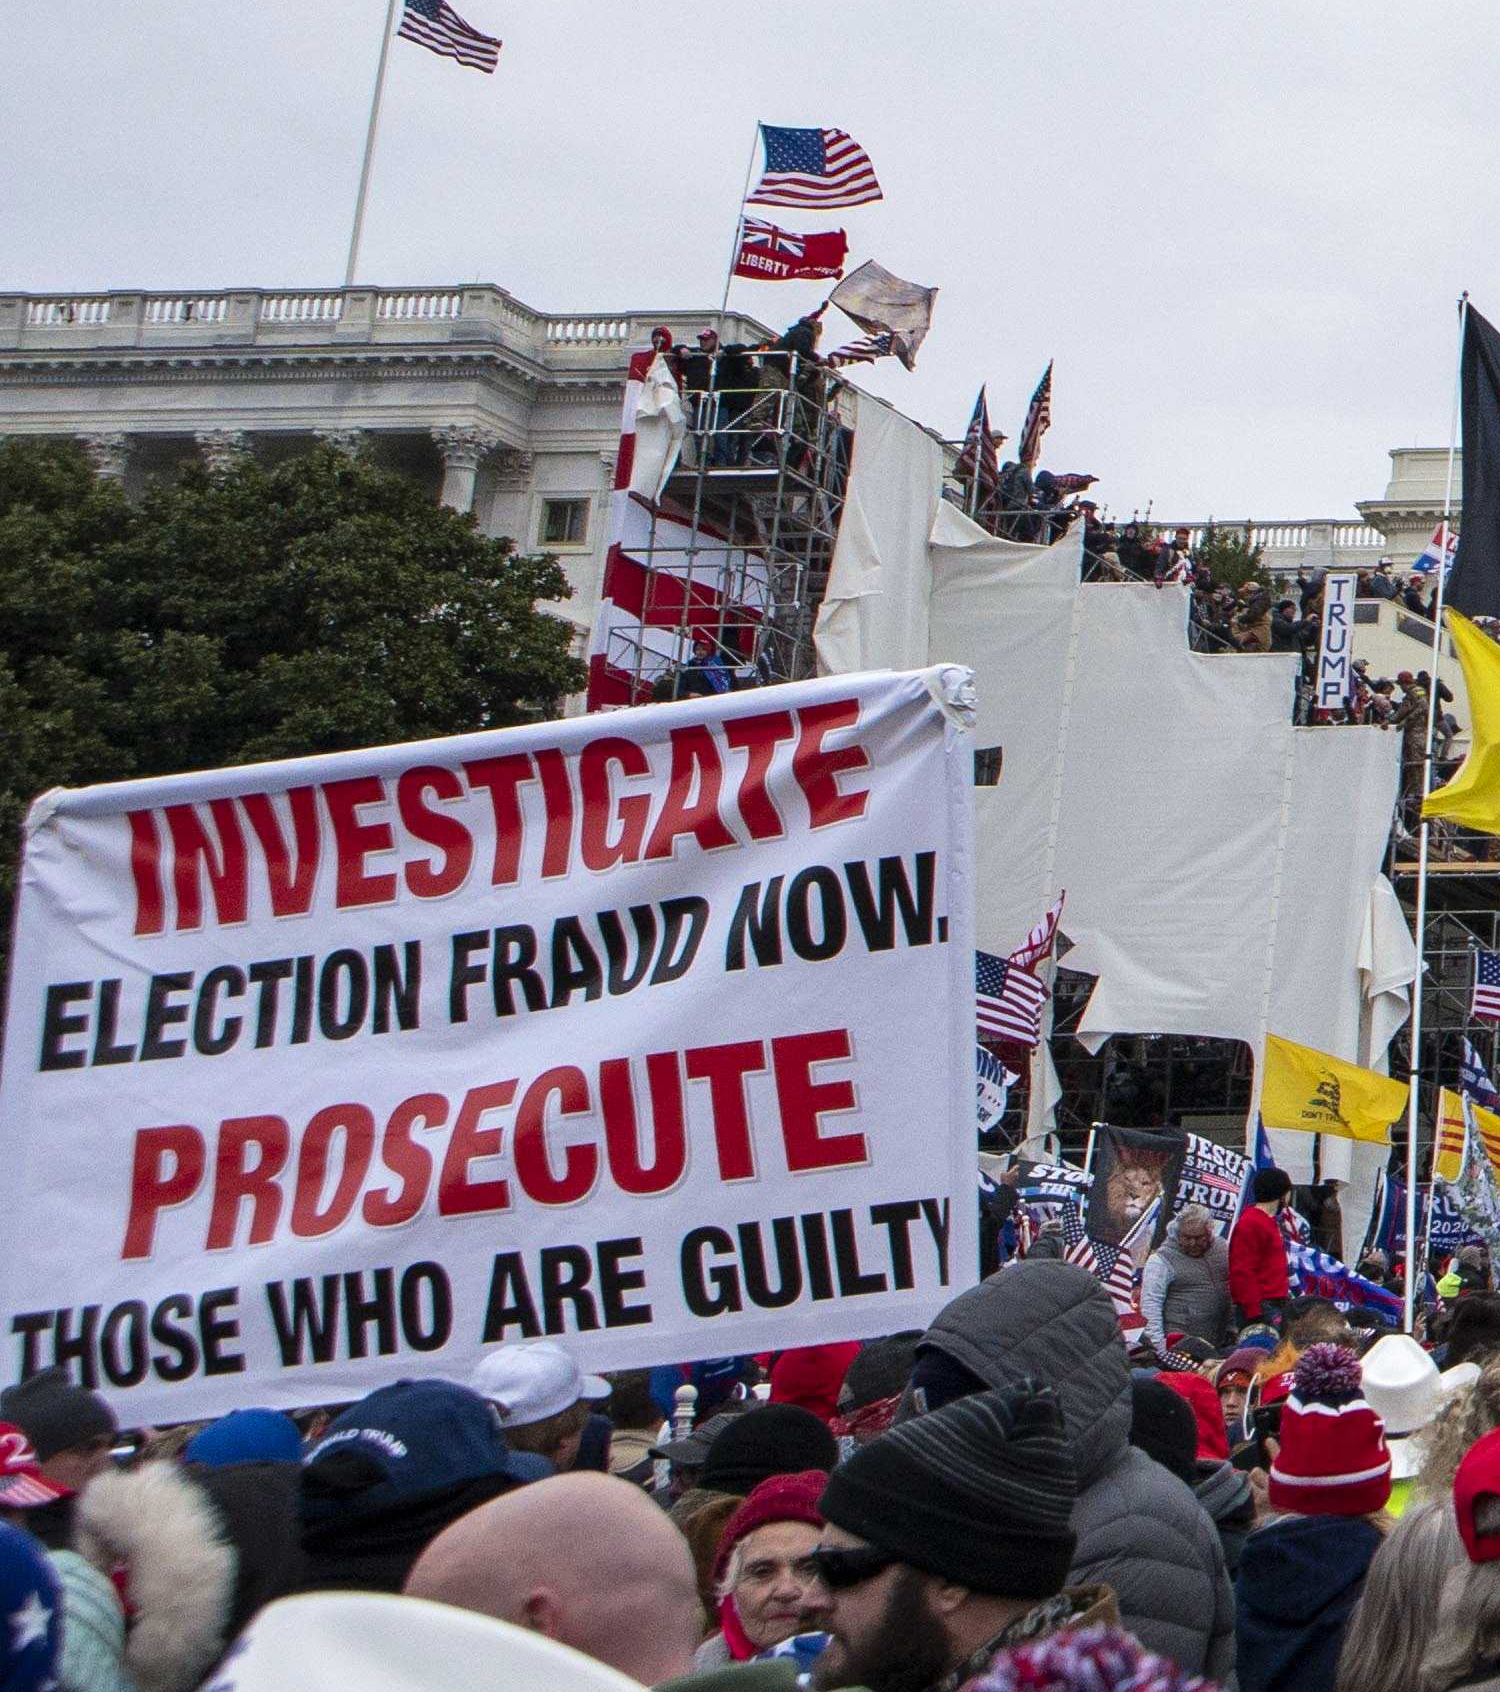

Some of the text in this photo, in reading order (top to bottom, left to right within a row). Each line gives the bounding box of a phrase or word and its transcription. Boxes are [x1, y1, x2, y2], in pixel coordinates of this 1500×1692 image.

[740, 252, 791, 277] LIBERTY
[1321, 580, 1348, 706] TRUMP
[127, 699, 871, 937] INVESTIGATE
[41, 850, 949, 1072] ELECTION FRAUD NOW.
[121, 1027, 869, 1261] PROSECUTE
[11, 1196, 952, 1390] THOSE WHO ARE GUILTY
[362, 1427, 409, 1458] TRUMP
